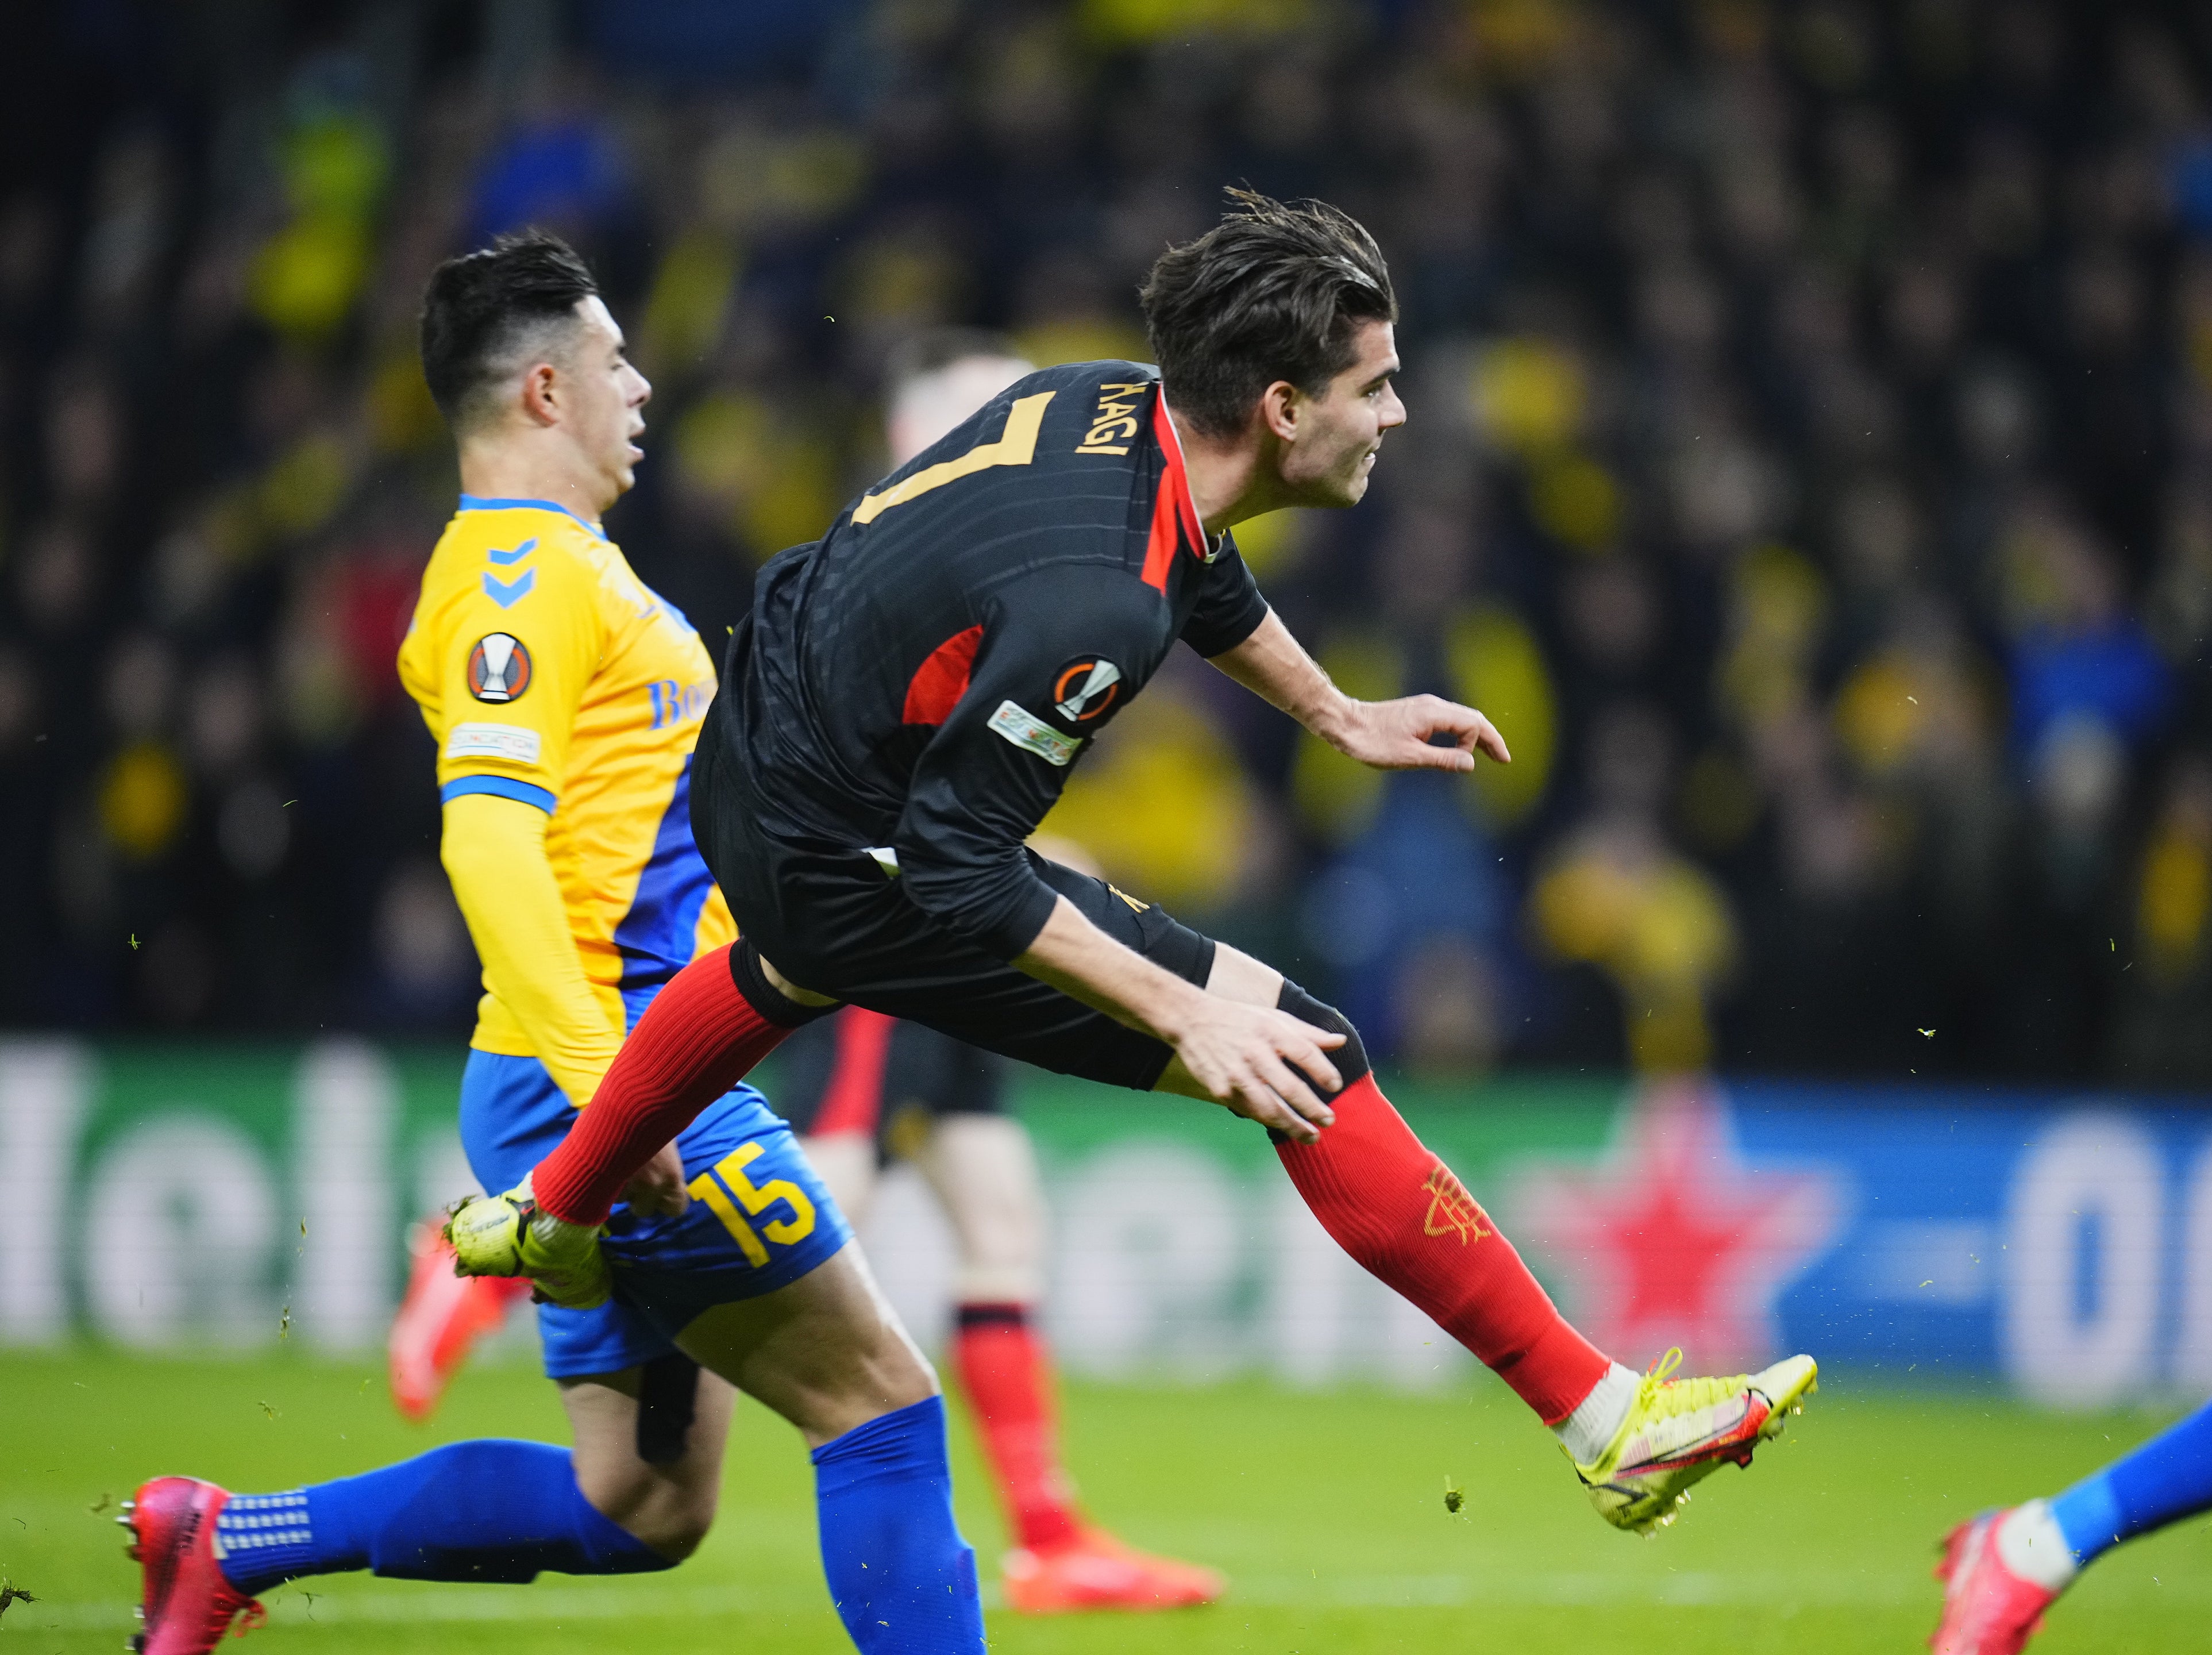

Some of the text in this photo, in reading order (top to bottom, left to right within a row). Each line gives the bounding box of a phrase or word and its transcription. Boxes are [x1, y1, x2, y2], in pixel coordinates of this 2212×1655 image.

[850, 391, 1057, 526] 7
[1074, 382, 1149, 456] HAGI
[685, 1141, 816, 1268] 15
